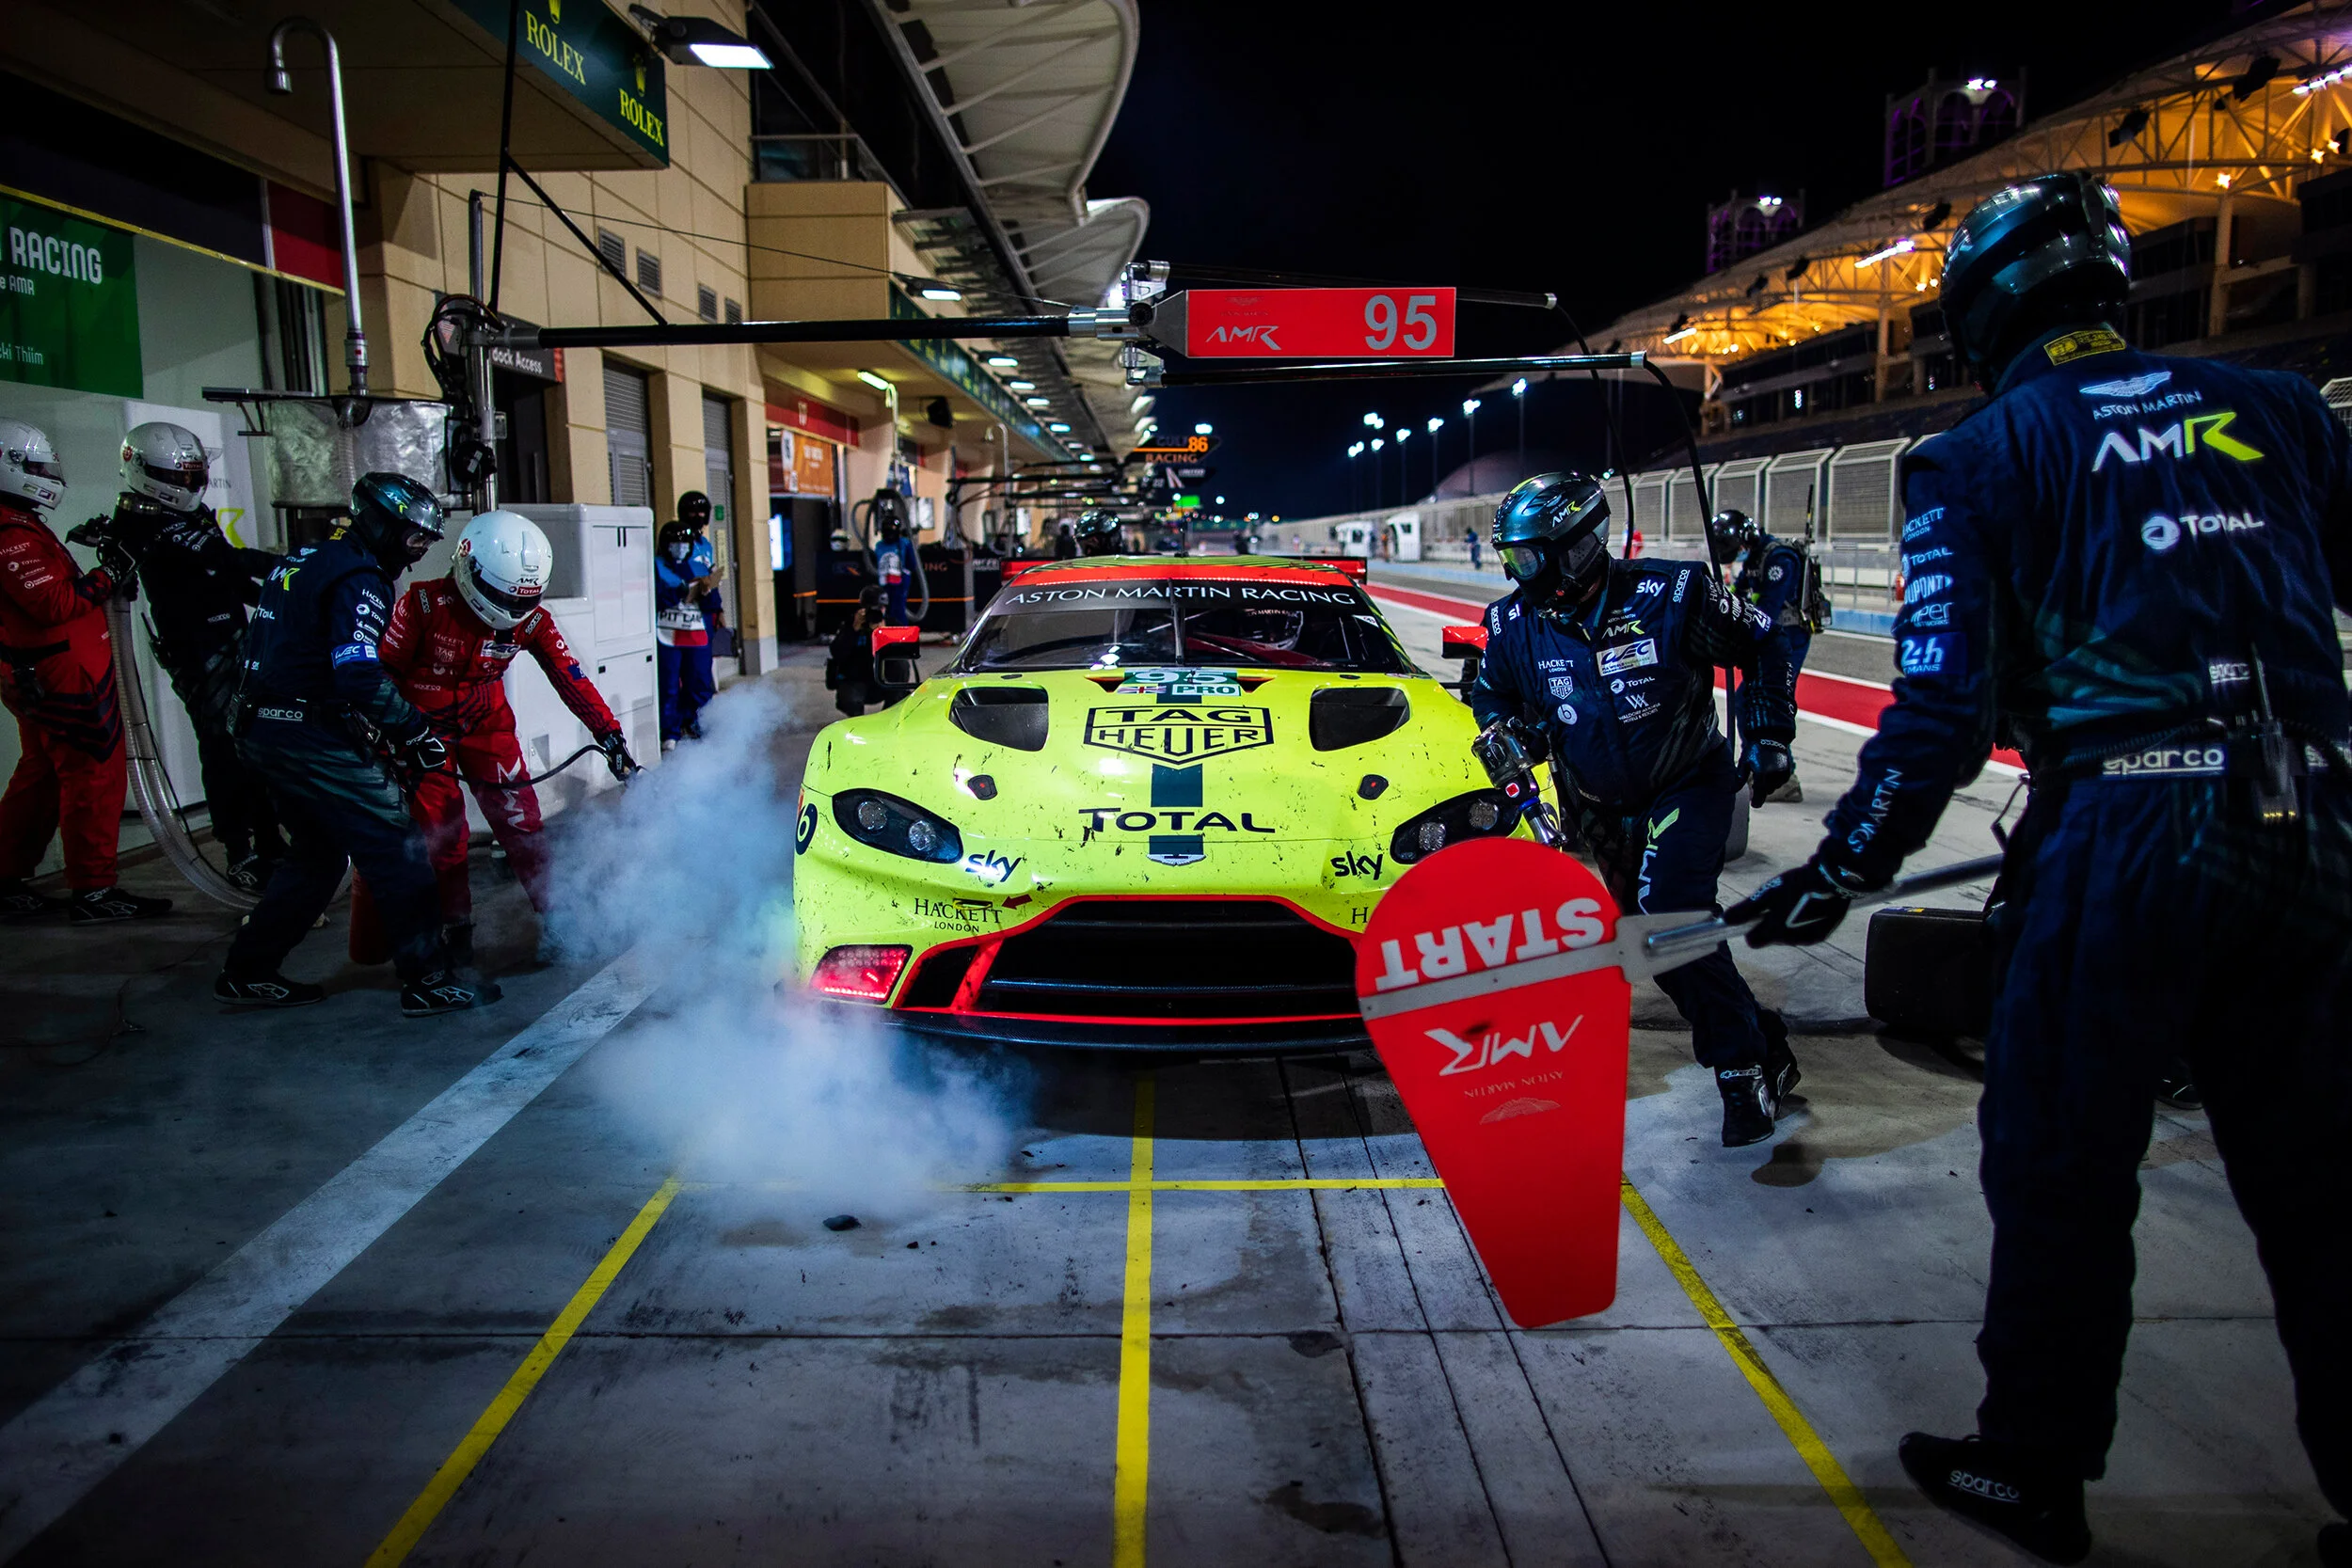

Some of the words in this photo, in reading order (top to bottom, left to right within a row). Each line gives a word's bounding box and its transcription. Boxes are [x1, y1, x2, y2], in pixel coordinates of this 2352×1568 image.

[525, 9, 587, 86] ROLEX
[619, 87, 665, 148] ROLEX
[9, 227, 103, 284] RACING
[9, 275, 35, 296] AMR
[1364, 294, 1438, 350] 95
[1205, 325, 1282, 351] AMR
[15, 345, 44, 366] Thiim
[515, 351, 543, 374] Access
[2092, 403, 2138, 420] ASTON
[2141, 391, 2202, 414] MARTIN
[1188, 436, 1209, 452] 86
[2091, 411, 2265, 472] AMR
[1145, 453, 1198, 463] RACING
[2179, 512, 2265, 536] TOTAL
[1910, 546, 1954, 566] TOTAL
[1005, 588, 1106, 606] ASTON
[1115, 586, 1231, 601] MARTIN
[1242, 587, 1357, 606] RACING
[1635, 578, 1665, 597] sky
[1673, 569, 1691, 603] sparco
[1601, 620, 1645, 640] AMR
[1135, 671, 1228, 684] 95
[1176, 685, 1236, 695] PRO
[1550, 678, 1570, 687] TAG
[1626, 676, 1656, 688] TOTAL
[258, 706, 304, 721] sparco
[1105, 709, 1252, 723] TAG
[1099, 727, 1260, 756] HEUER
[2103, 749, 2226, 775] sparco
[1078, 807, 1276, 833] TOTAL
[965, 849, 1023, 883] sky
[1329, 849, 1384, 881] sky
[914, 897, 1003, 925] HACKETT
[934, 921, 980, 933] LONDON
[1375, 897, 1605, 992] START
[1422, 1014, 1584, 1077] AMR
[1947, 1469, 2021, 1503] sparco
